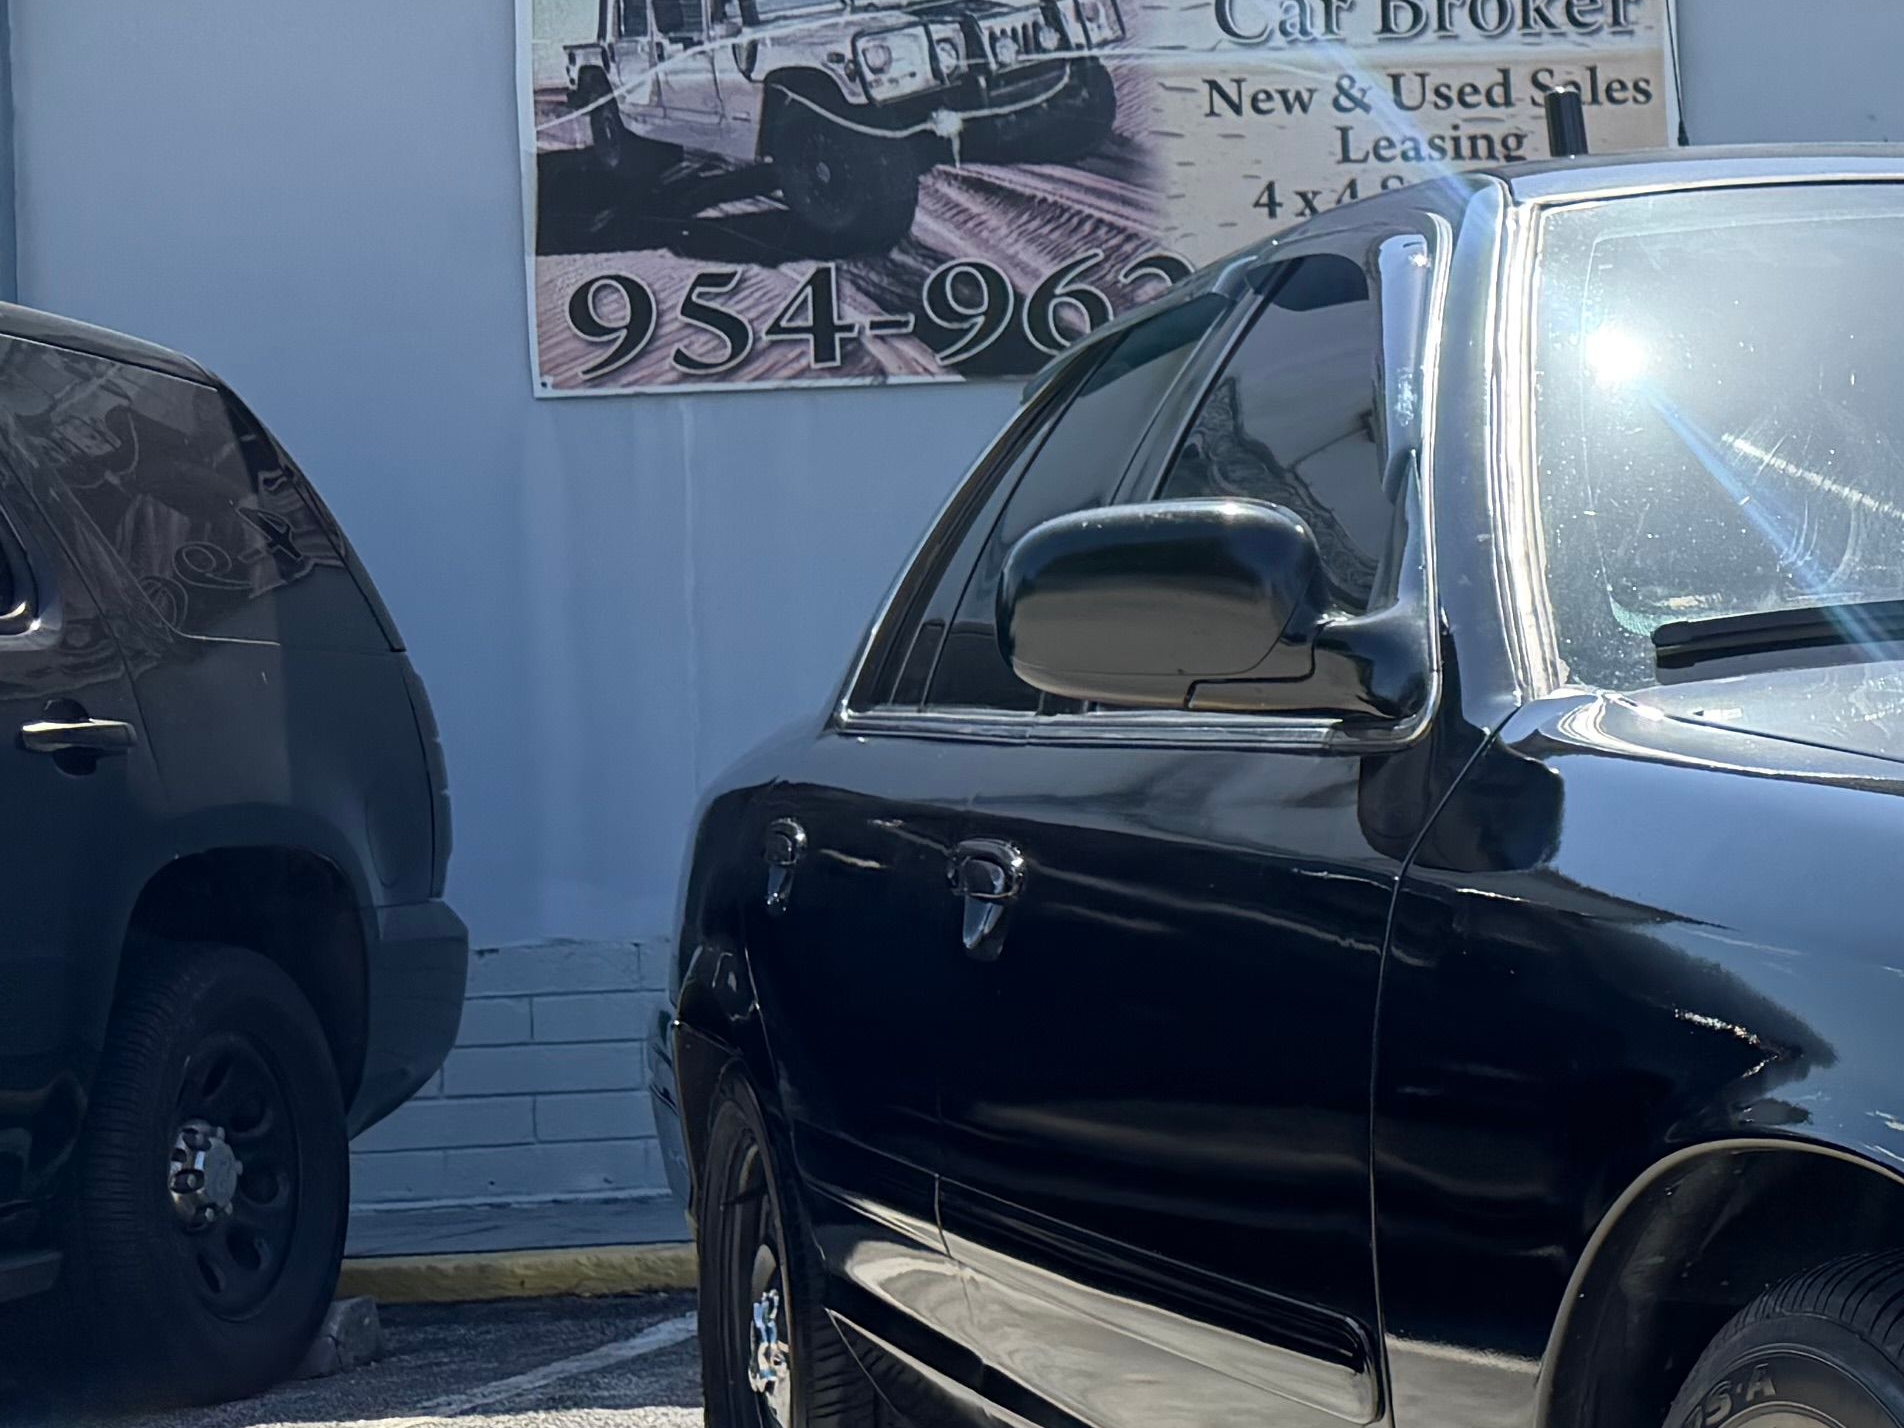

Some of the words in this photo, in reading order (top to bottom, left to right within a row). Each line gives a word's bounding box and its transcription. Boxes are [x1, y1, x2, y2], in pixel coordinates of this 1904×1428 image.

[1203, 76, 1317, 118] New
[1332, 74, 1373, 115] &
[1386, 68, 1514, 112] Used
[1334, 123, 1529, 164] Leasing
